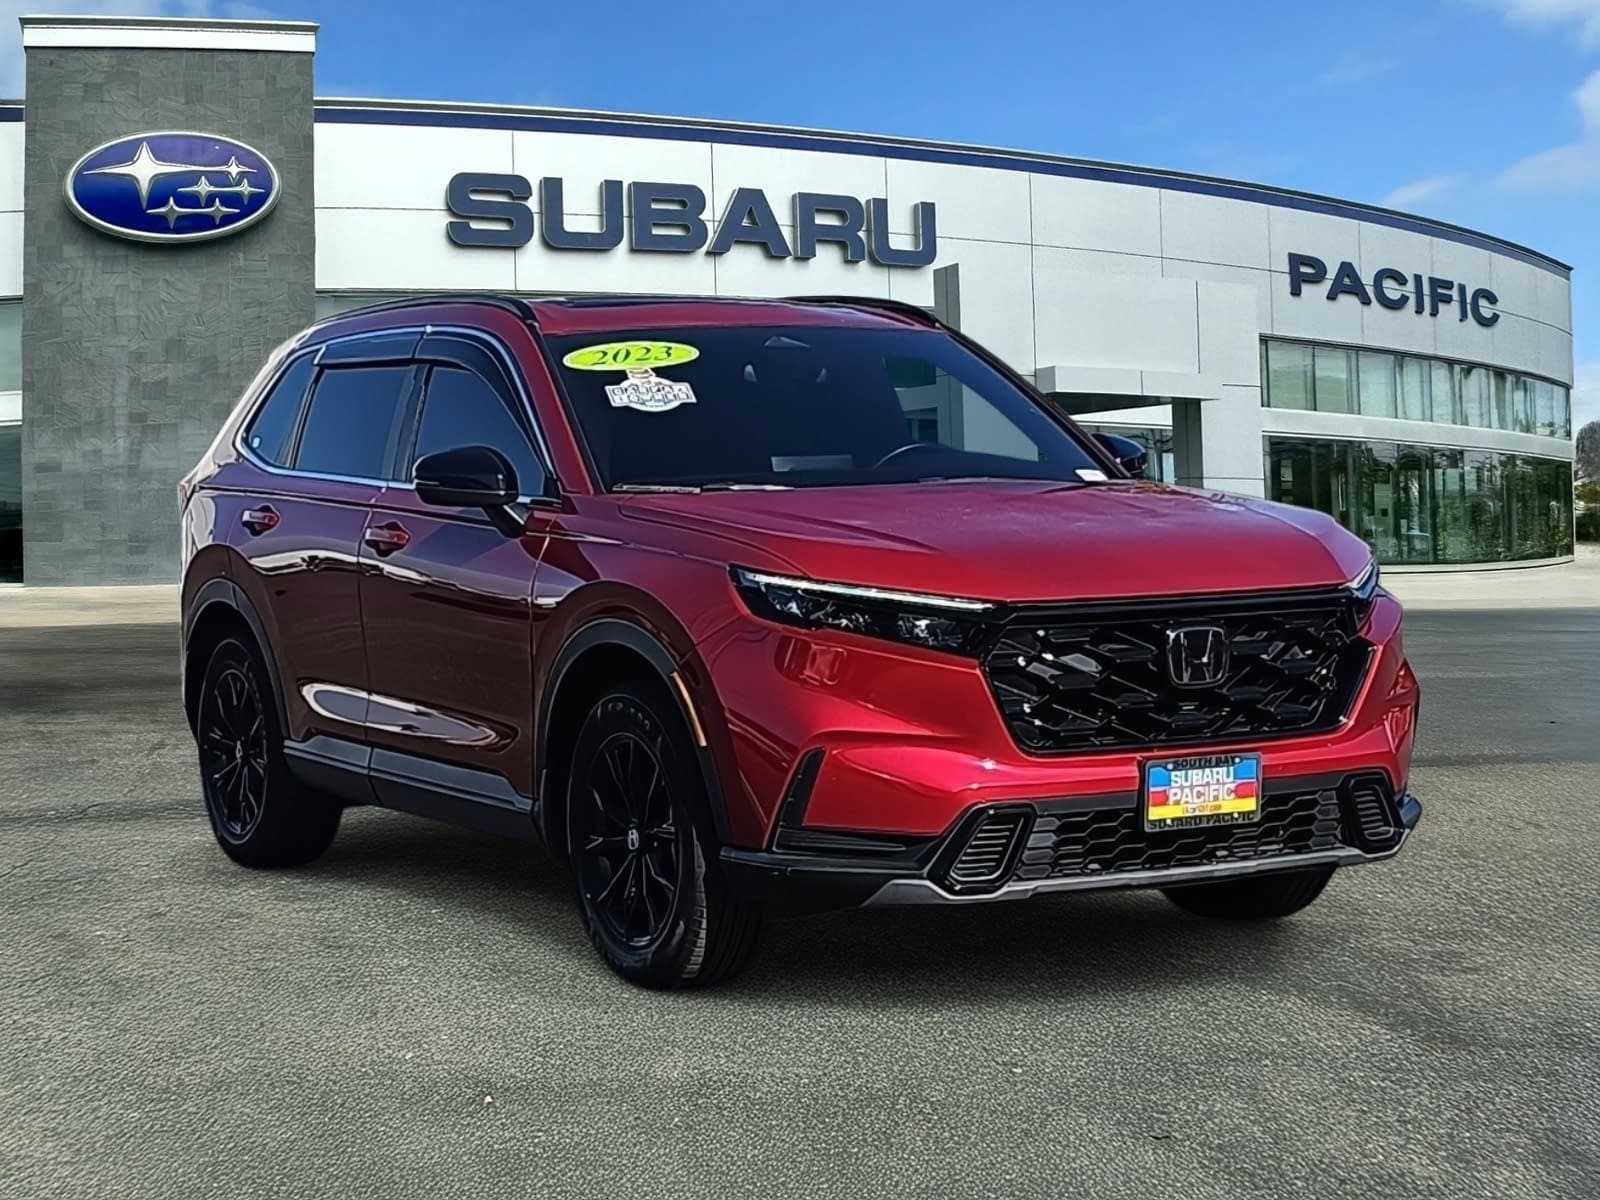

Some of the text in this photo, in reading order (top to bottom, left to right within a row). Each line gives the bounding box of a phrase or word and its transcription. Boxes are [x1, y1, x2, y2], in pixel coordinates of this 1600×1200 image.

[446, 172, 937, 268] SUBARU
[1288, 252, 1500, 328] PACIFIC
[591, 346, 673, 366] 2023
[1174, 755, 1237, 769] SOUTH BAY
[1170, 766, 1235, 787] SUBARU
[1168, 782, 1237, 805] PACIFIC
